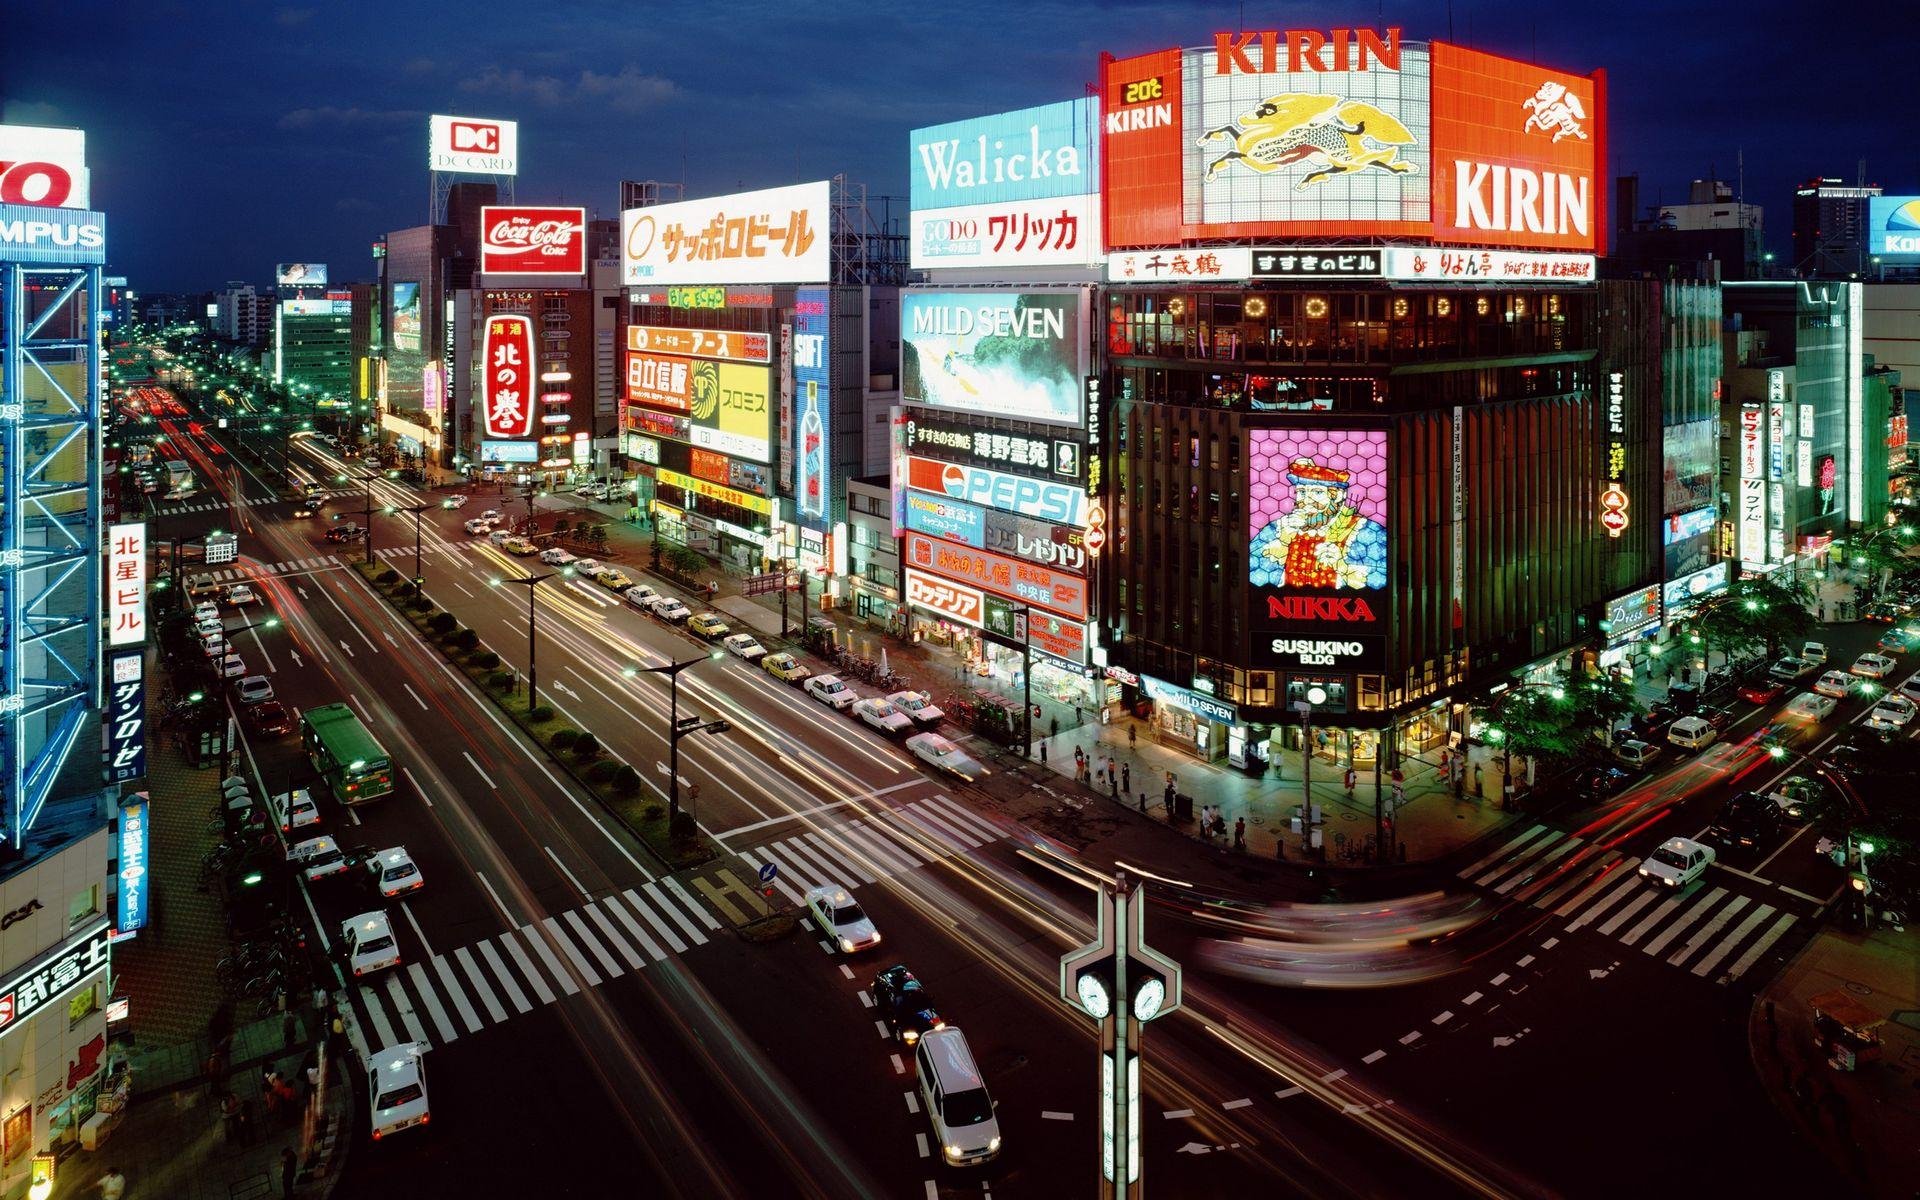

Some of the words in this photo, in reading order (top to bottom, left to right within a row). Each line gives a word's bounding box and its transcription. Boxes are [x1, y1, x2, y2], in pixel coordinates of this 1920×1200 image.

[1215, 28, 1400, 75] KIRIN
[1107, 103, 1172, 134] KIRIN
[455, 125, 496, 150] DC
[438, 155, 462, 168] DC
[467, 156, 513, 170] CARD
[919, 124, 1080, 190] Walicka
[1455, 160, 1588, 236] KIRIN
[662, 209, 815, 263] サッポロビール
[989, 210, 1077, 252] ワリッカ
[1885, 235, 1920, 252] Ko
[1145, 253, 1223, 277] 千歳鶴
[1258, 255, 1375, 271] すすきのビル
[913, 305, 975, 336] MILD
[976, 306, 1064, 340] SEVEN
[490, 342, 524, 429] 北の誉
[629, 358, 688, 395] 日立信販
[722, 389, 766, 413] プロミス
[965, 469, 1082, 524] PEPSI
[114, 536, 141, 631] 北星ビル
[909, 577, 978, 616] ロッテリア
[1016, 582, 1051, 604] 中央店
[1267, 595, 1376, 620] NIKKA
[1612, 605, 1643, 626] Dress
[1272, 639, 1363, 657] SUSUKINO
[1300, 654, 1335, 666] BLDG
[1175, 692, 1200, 708] MILD
[1200, 700, 1232, 720] SEVEN
[117, 767, 137, 779] B1
[18, 938, 107, 1015] 武富士
